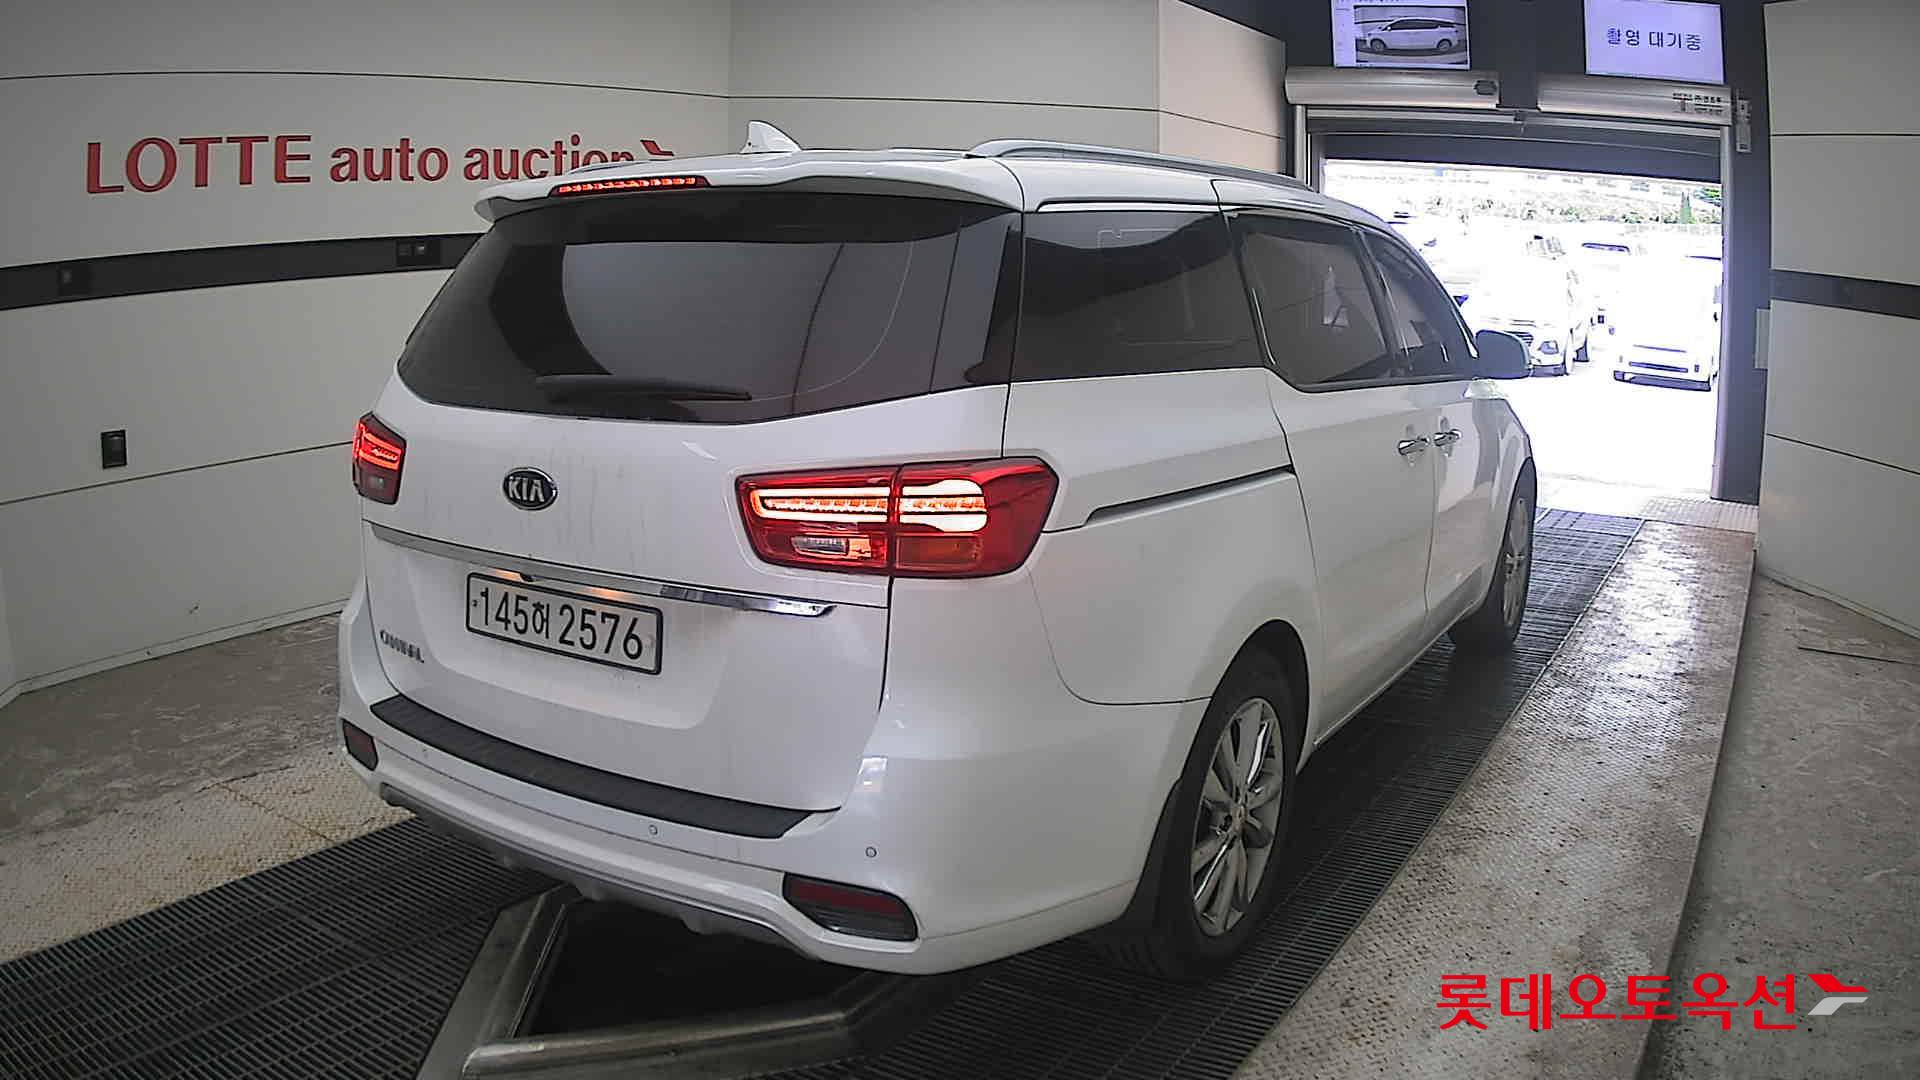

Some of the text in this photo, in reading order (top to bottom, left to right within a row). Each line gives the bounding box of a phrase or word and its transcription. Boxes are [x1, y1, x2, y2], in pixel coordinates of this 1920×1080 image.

[1648, 31, 1701, 51] 대기중
[86, 135, 312, 194] LOTTE
[329, 137, 449, 183] auto
[507, 476, 545, 503] KIA
[480, 587, 643, 660] 145허 2576
